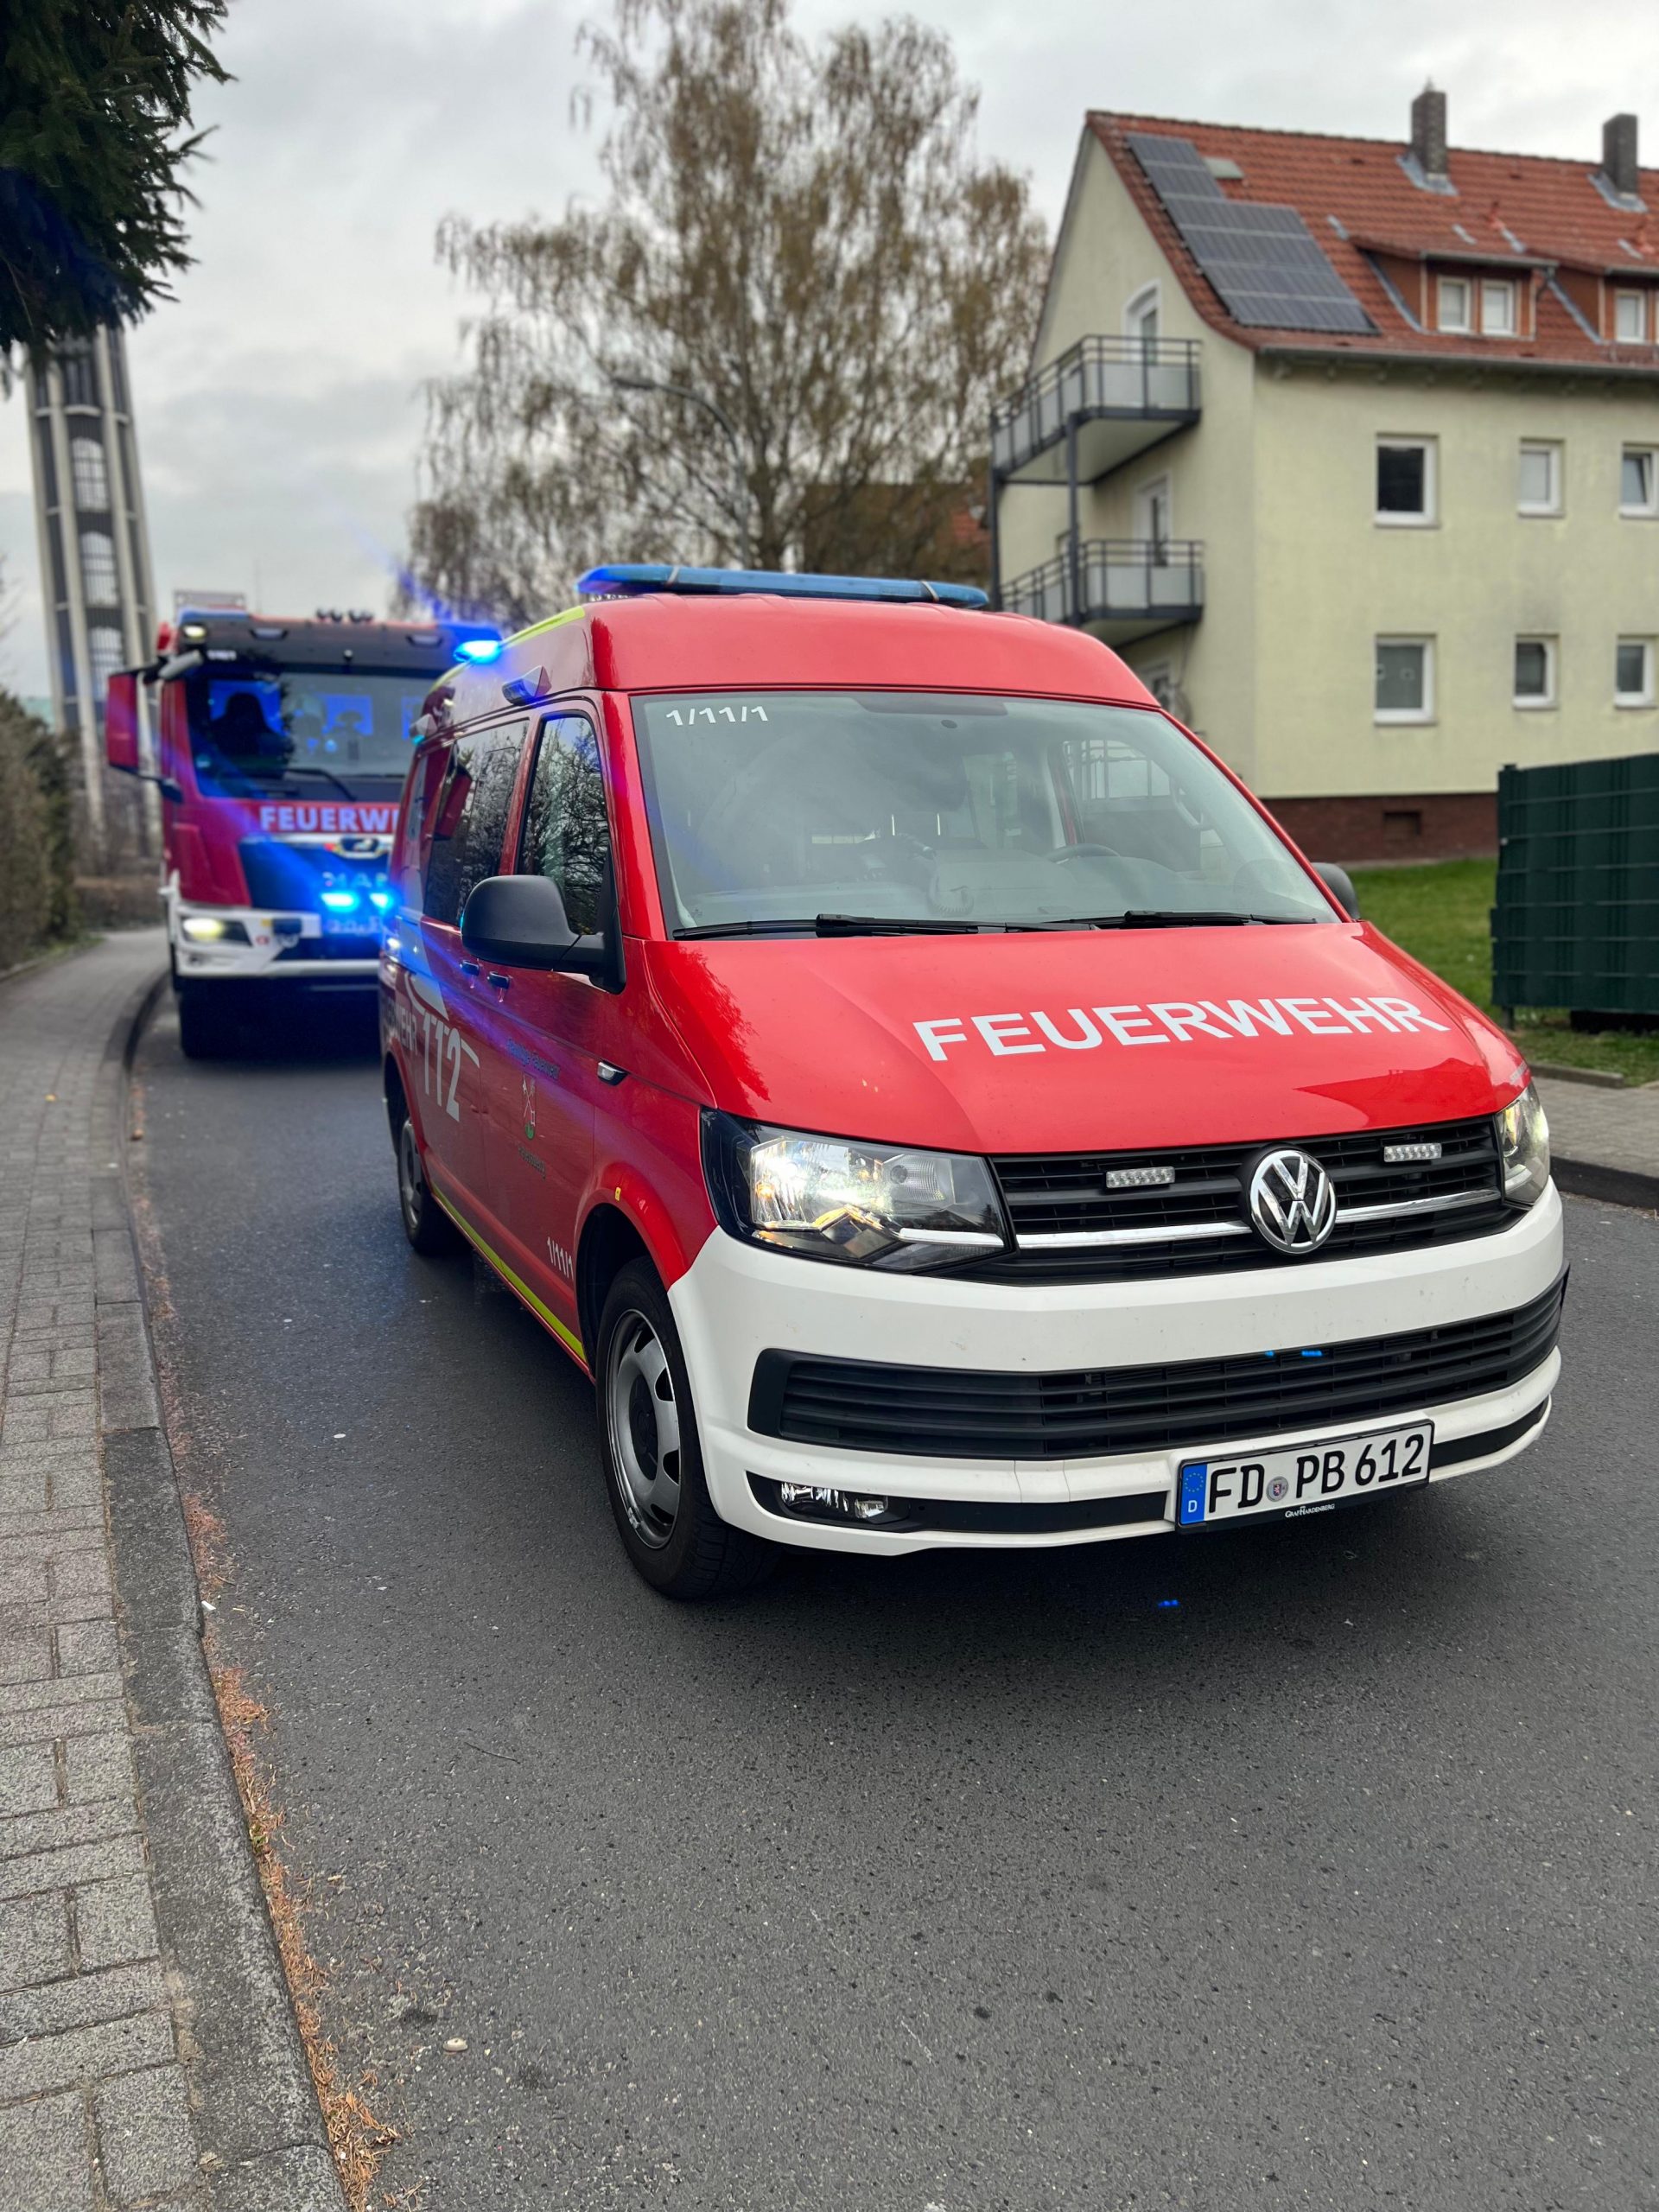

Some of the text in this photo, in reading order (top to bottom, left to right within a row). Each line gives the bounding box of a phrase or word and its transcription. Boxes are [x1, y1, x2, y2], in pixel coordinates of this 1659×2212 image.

[665, 705, 768, 726] 1/11/1
[912, 996, 1451, 1062] FEUERWEHR
[423, 1011, 461, 1122] 112
[546, 1236, 575, 1281] 1/11/1
[1209, 1433, 1425, 1513] FD PB 612
[1188, 1499, 1198, 1513] D
